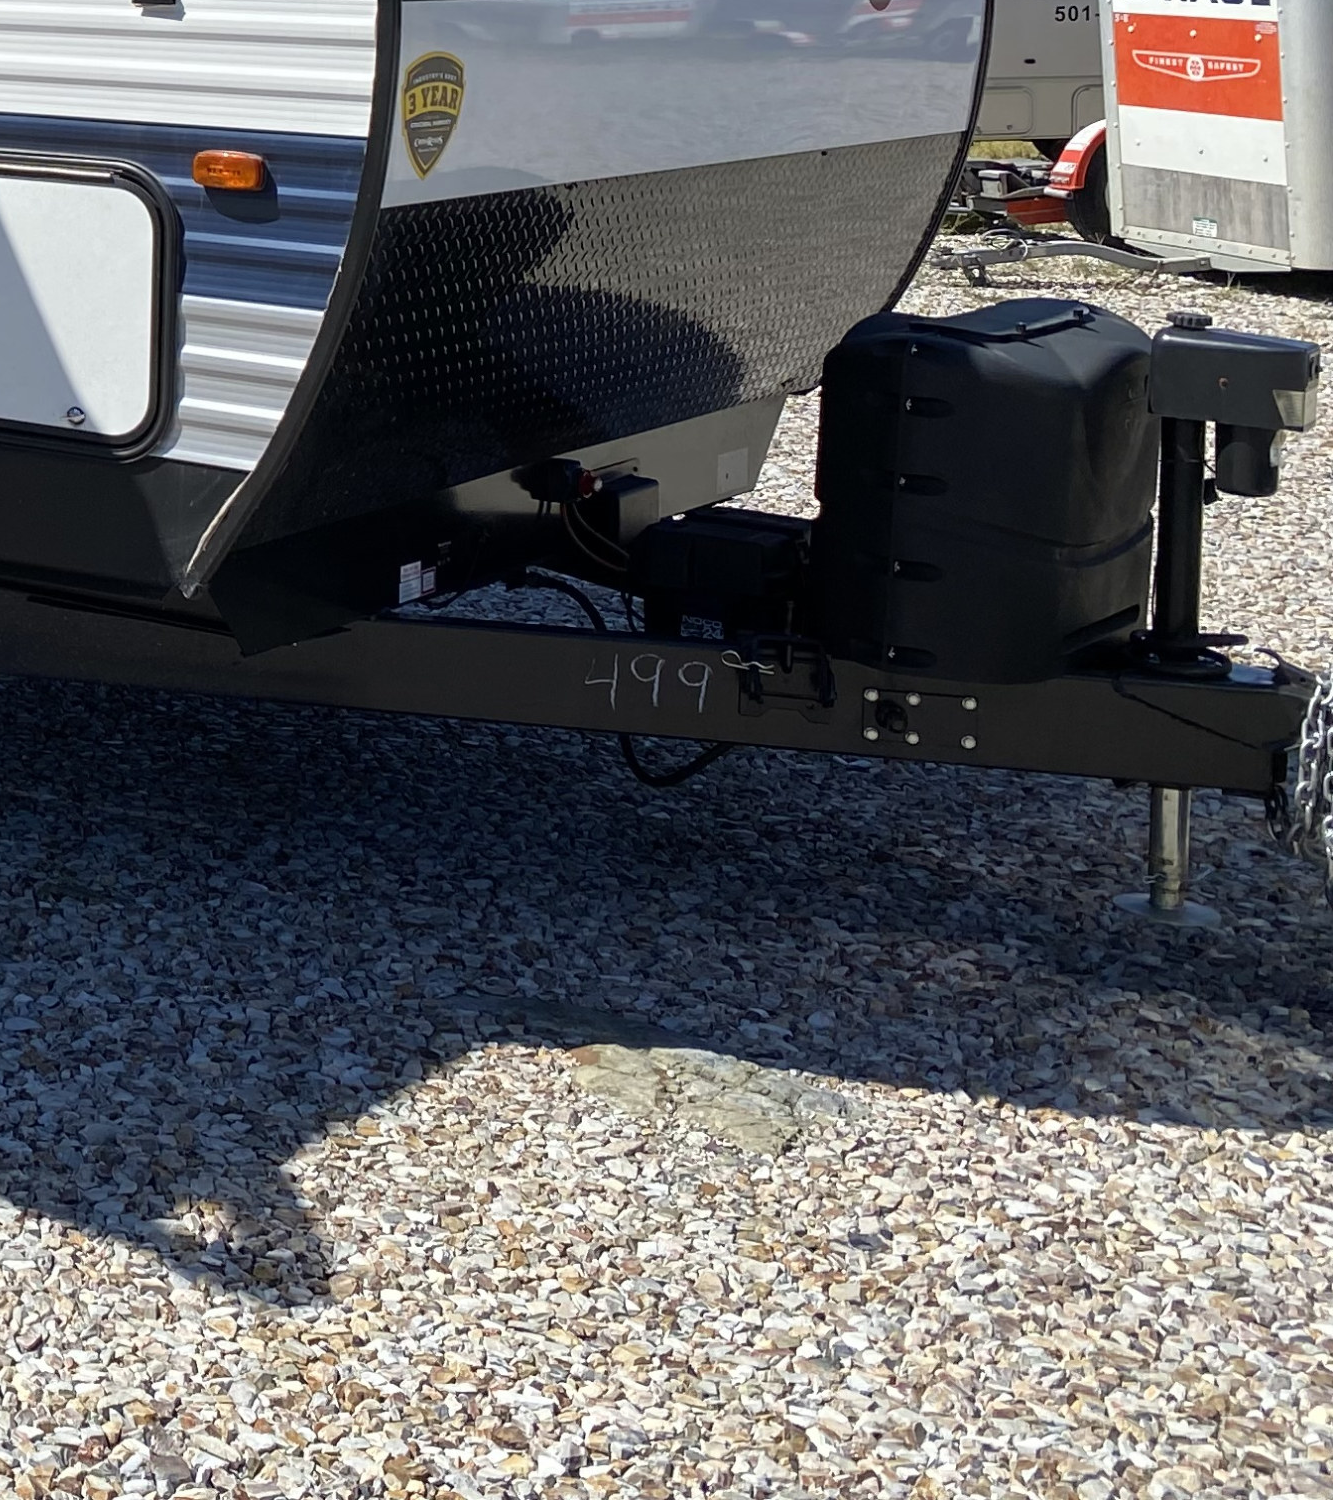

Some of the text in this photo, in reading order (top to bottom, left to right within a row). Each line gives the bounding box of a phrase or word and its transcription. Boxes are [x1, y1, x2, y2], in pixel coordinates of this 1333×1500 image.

[1148, 56, 1244, 71] FINEST SAFEST
[408, 85, 459, 115] 3 YEAR
[585, 653, 713, 713] 499
